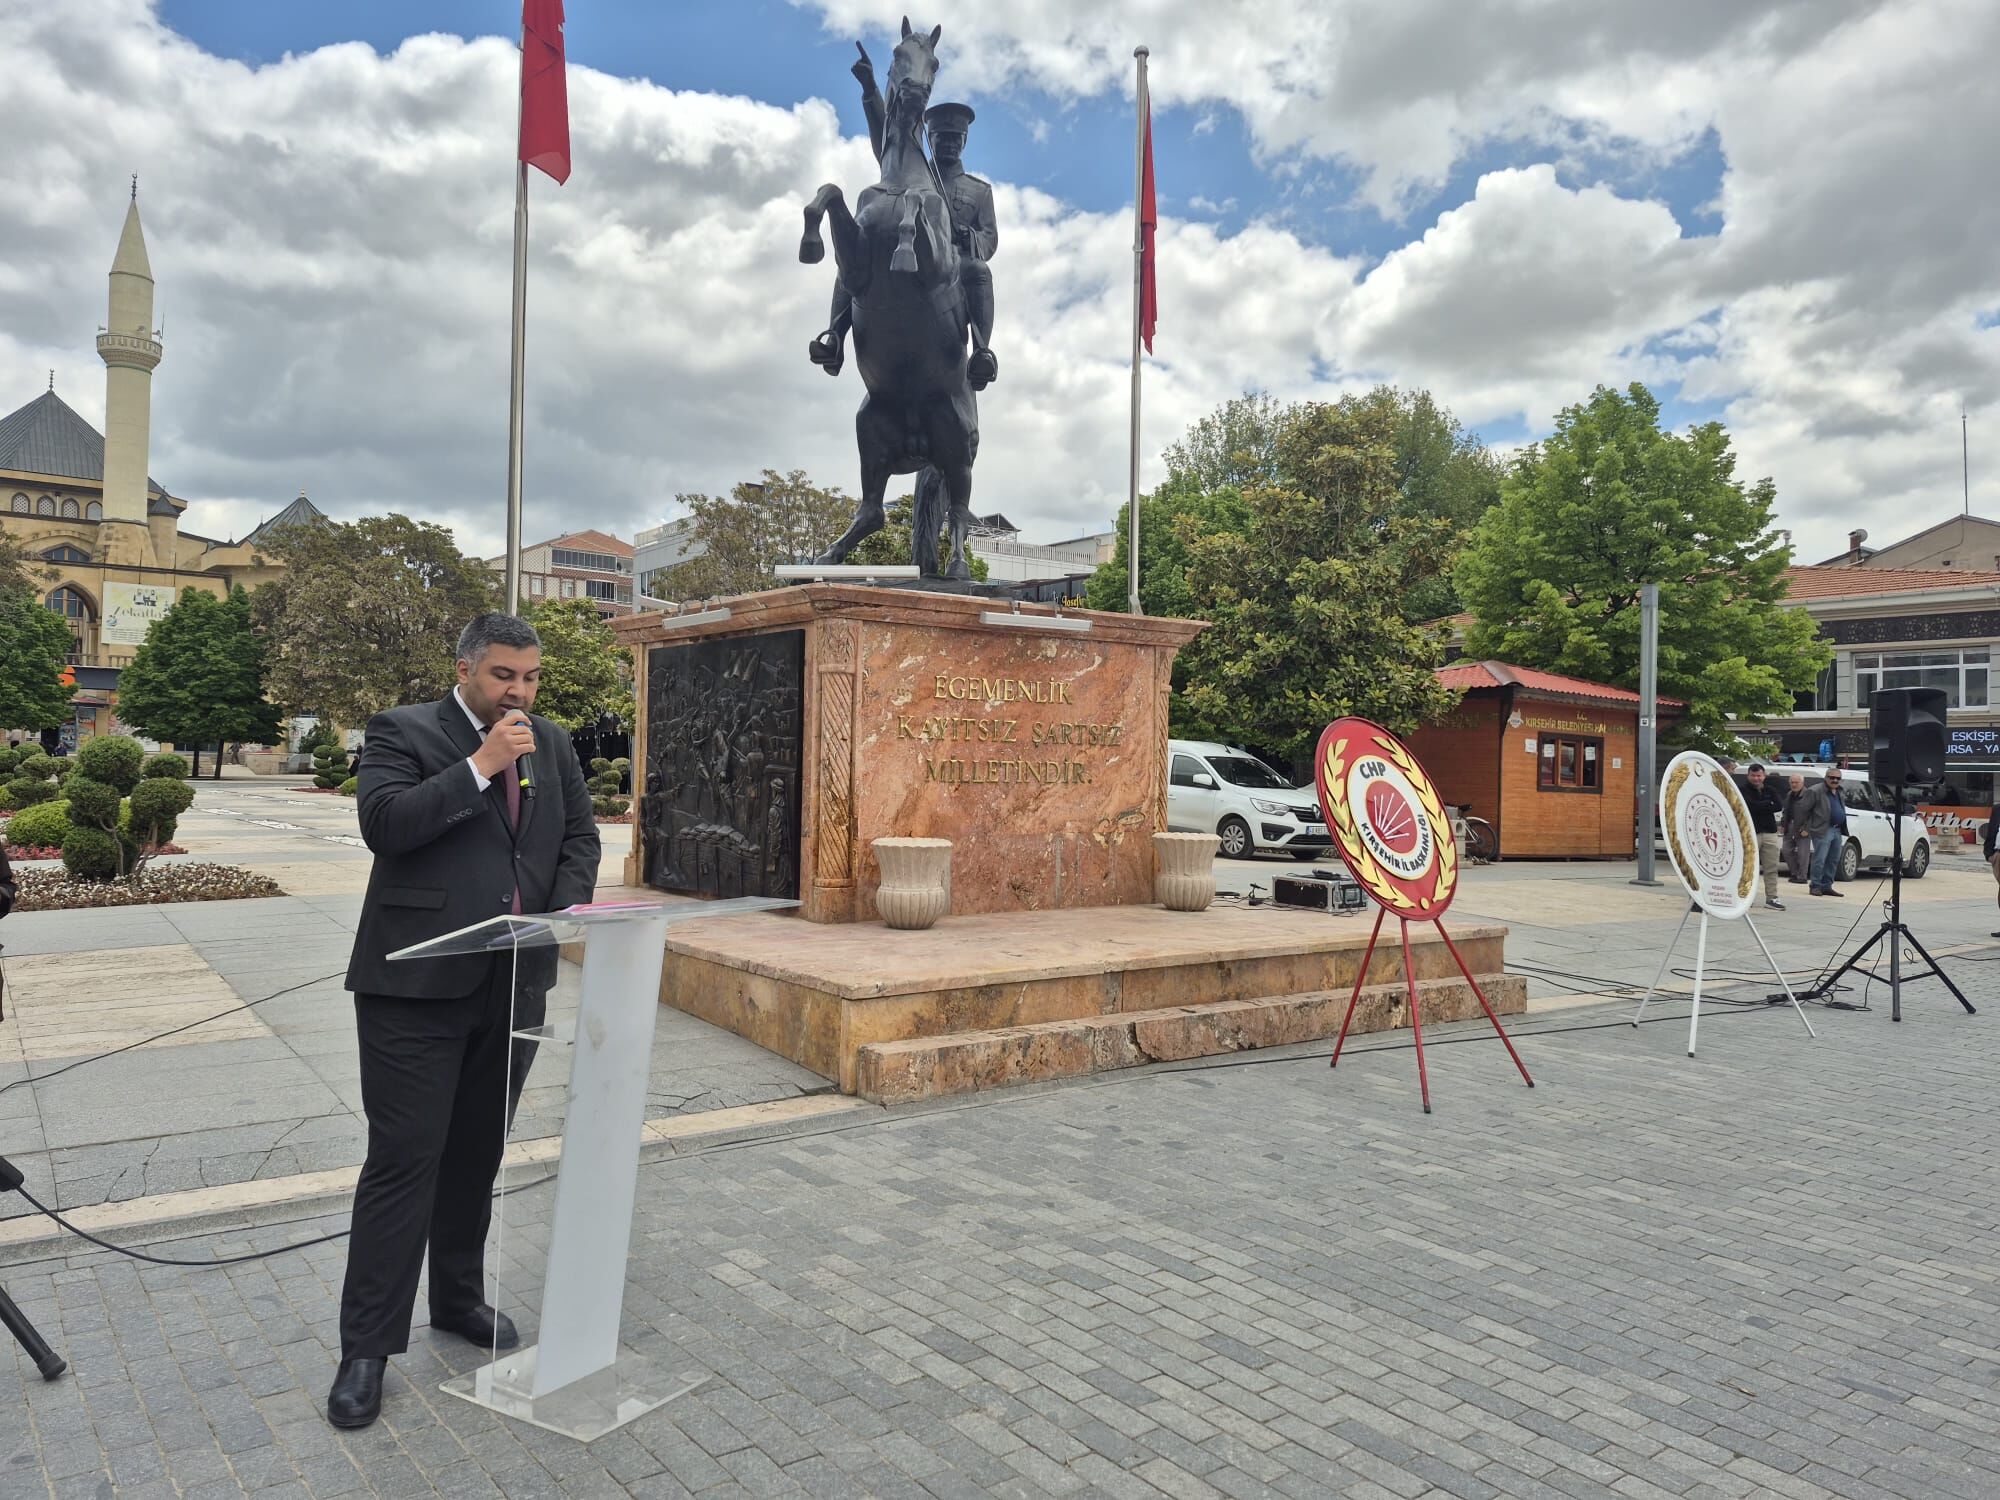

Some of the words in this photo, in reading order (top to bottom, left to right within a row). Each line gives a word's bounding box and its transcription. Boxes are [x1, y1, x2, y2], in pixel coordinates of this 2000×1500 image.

[934, 675, 1072, 704] EGEMENLİK
[897, 715, 1017, 743] KAYITSIZ
[1031, 722, 1123, 748] ŞARTSIZ
[925, 755, 1093, 785] MİLLETİNDİR.
[1360, 761, 1386, 779] CHP
[1361, 822, 1401, 870] KIRŞEHİR
[1401, 858, 1411, 872] İL
[1410, 814, 1429, 872] BAŞKANLIĞI
